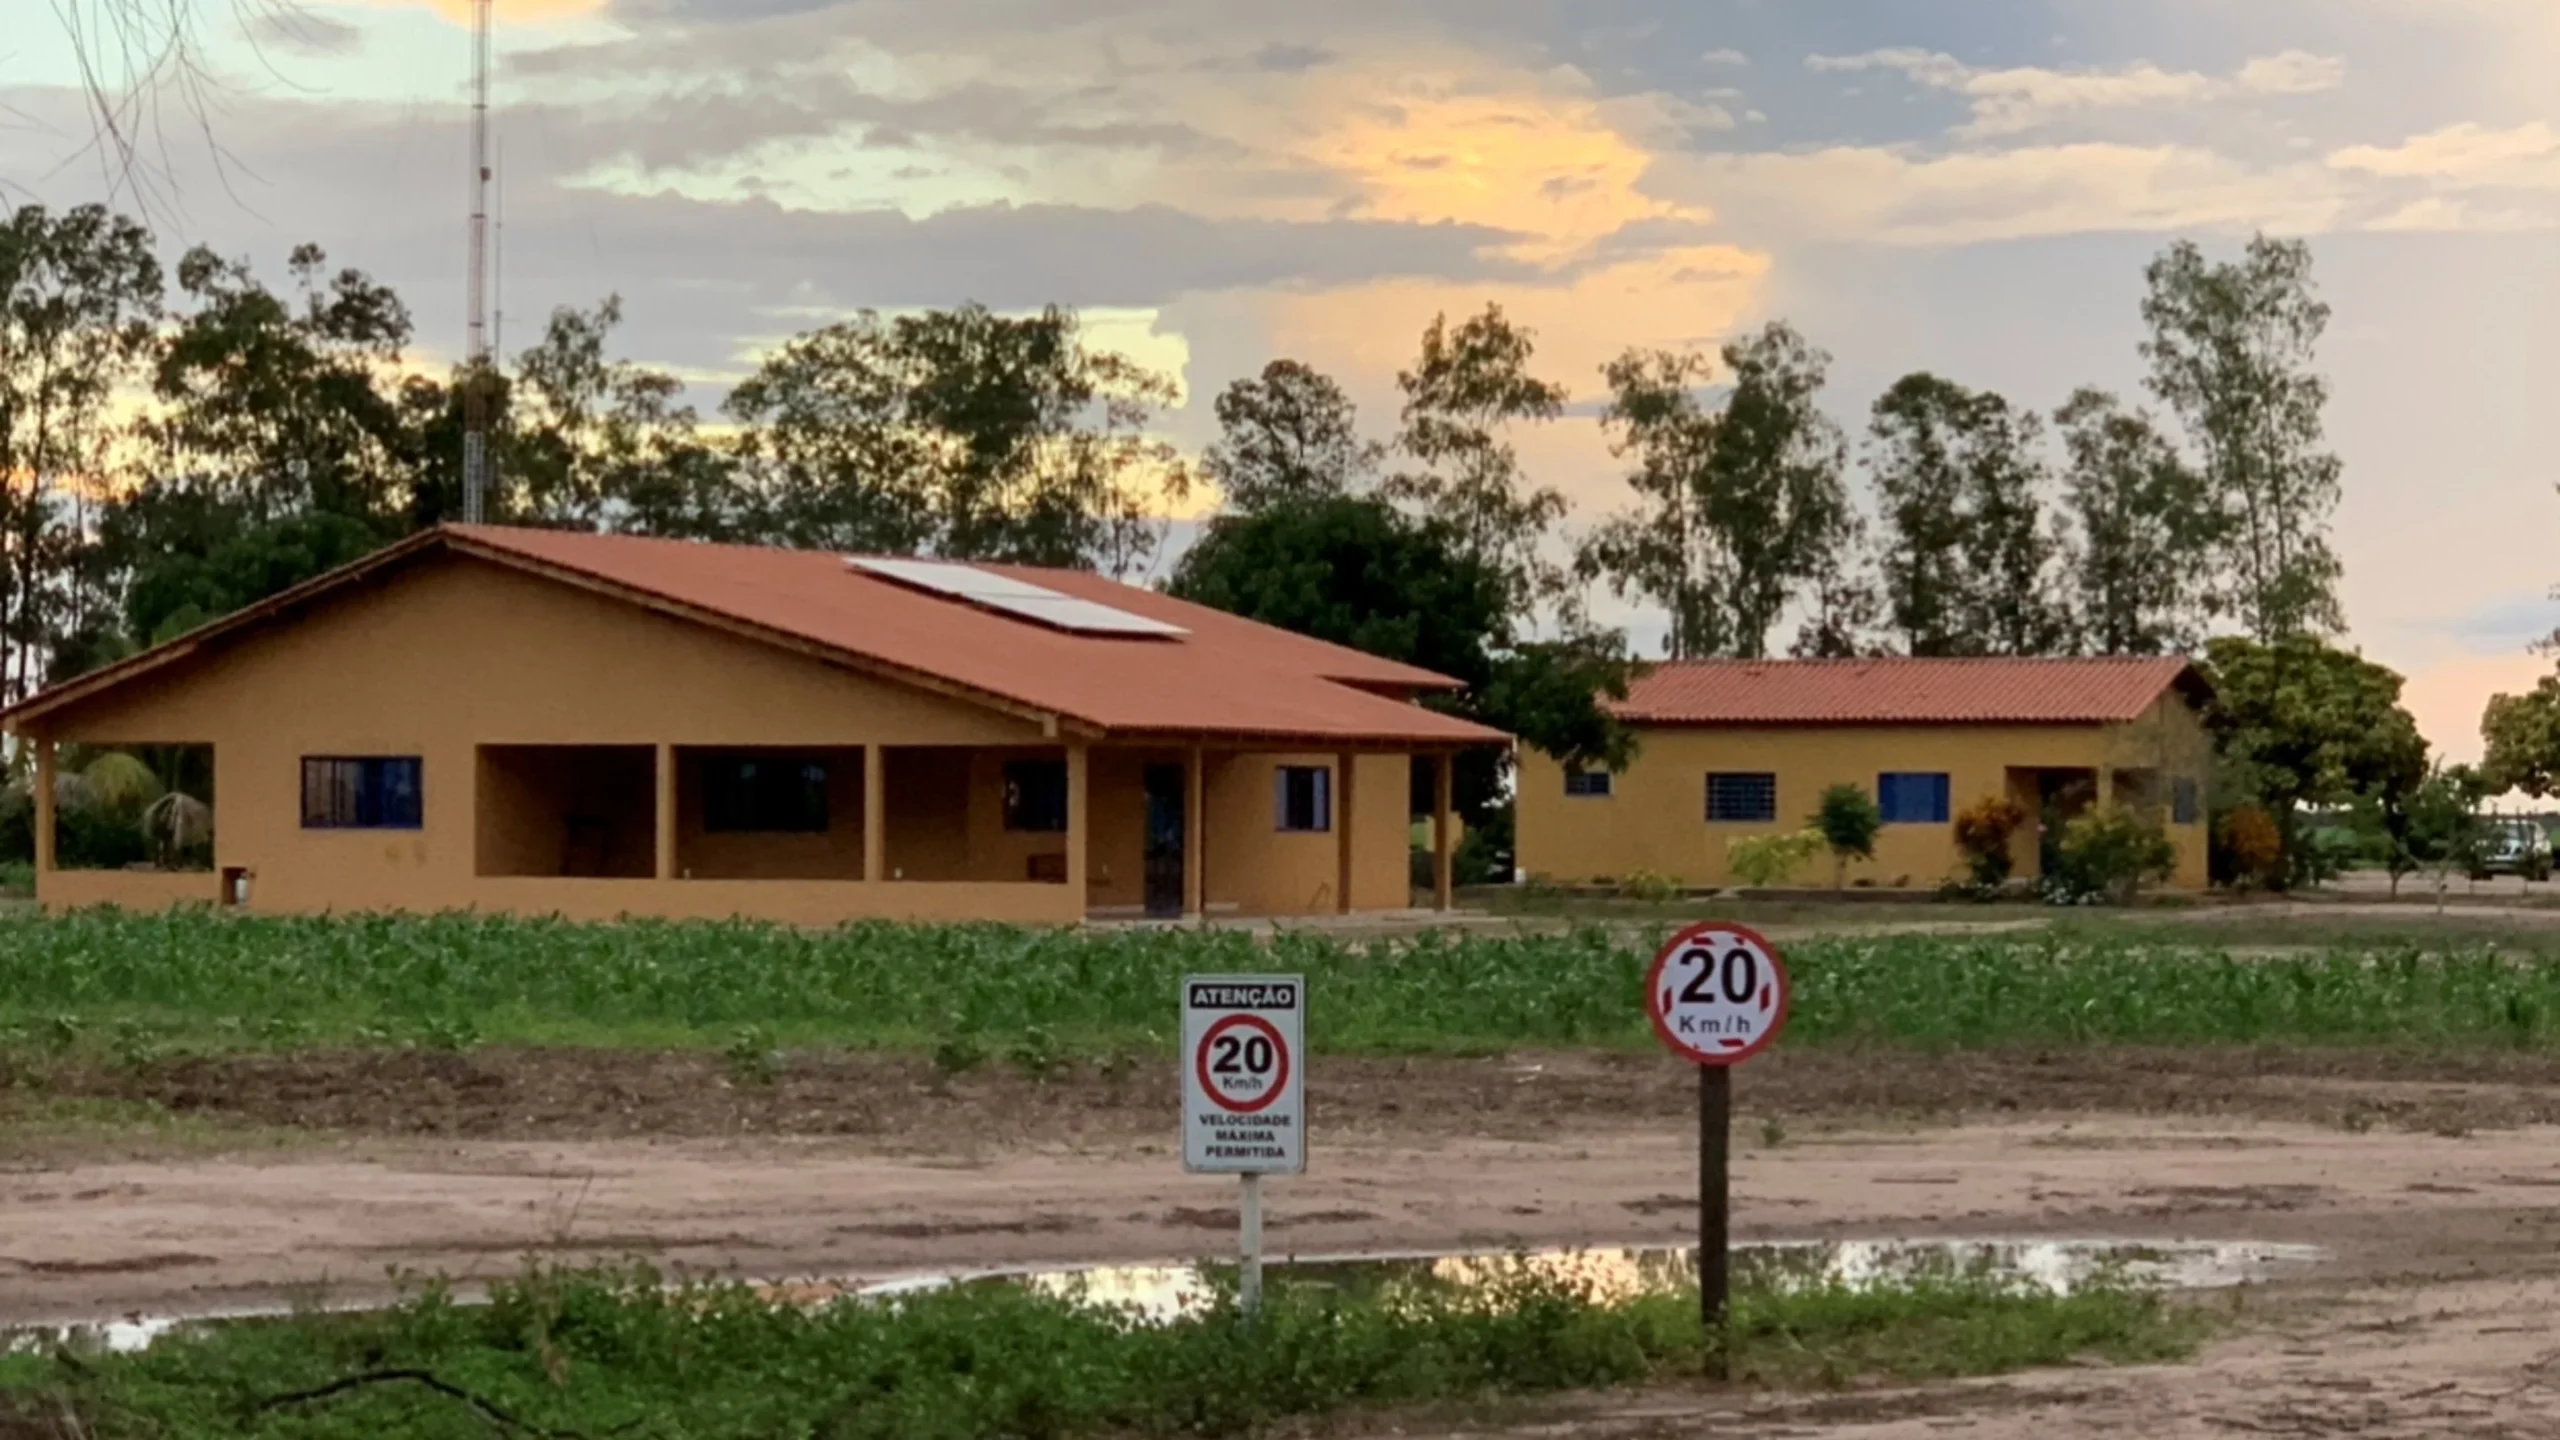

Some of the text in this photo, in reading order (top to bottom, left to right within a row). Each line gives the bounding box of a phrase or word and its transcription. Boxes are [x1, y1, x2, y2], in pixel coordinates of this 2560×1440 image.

[1679, 947, 1757, 1004] 20
[1194, 986, 1292, 1008] ATENÇÃO
[1213, 1035, 1273, 1074] 20
[1223, 1076, 1263, 1090] Km/h
[1200, 1114, 1291, 1126] VELOCIDADE
[1205, 1146, 1285, 1158] PERMITIDA
